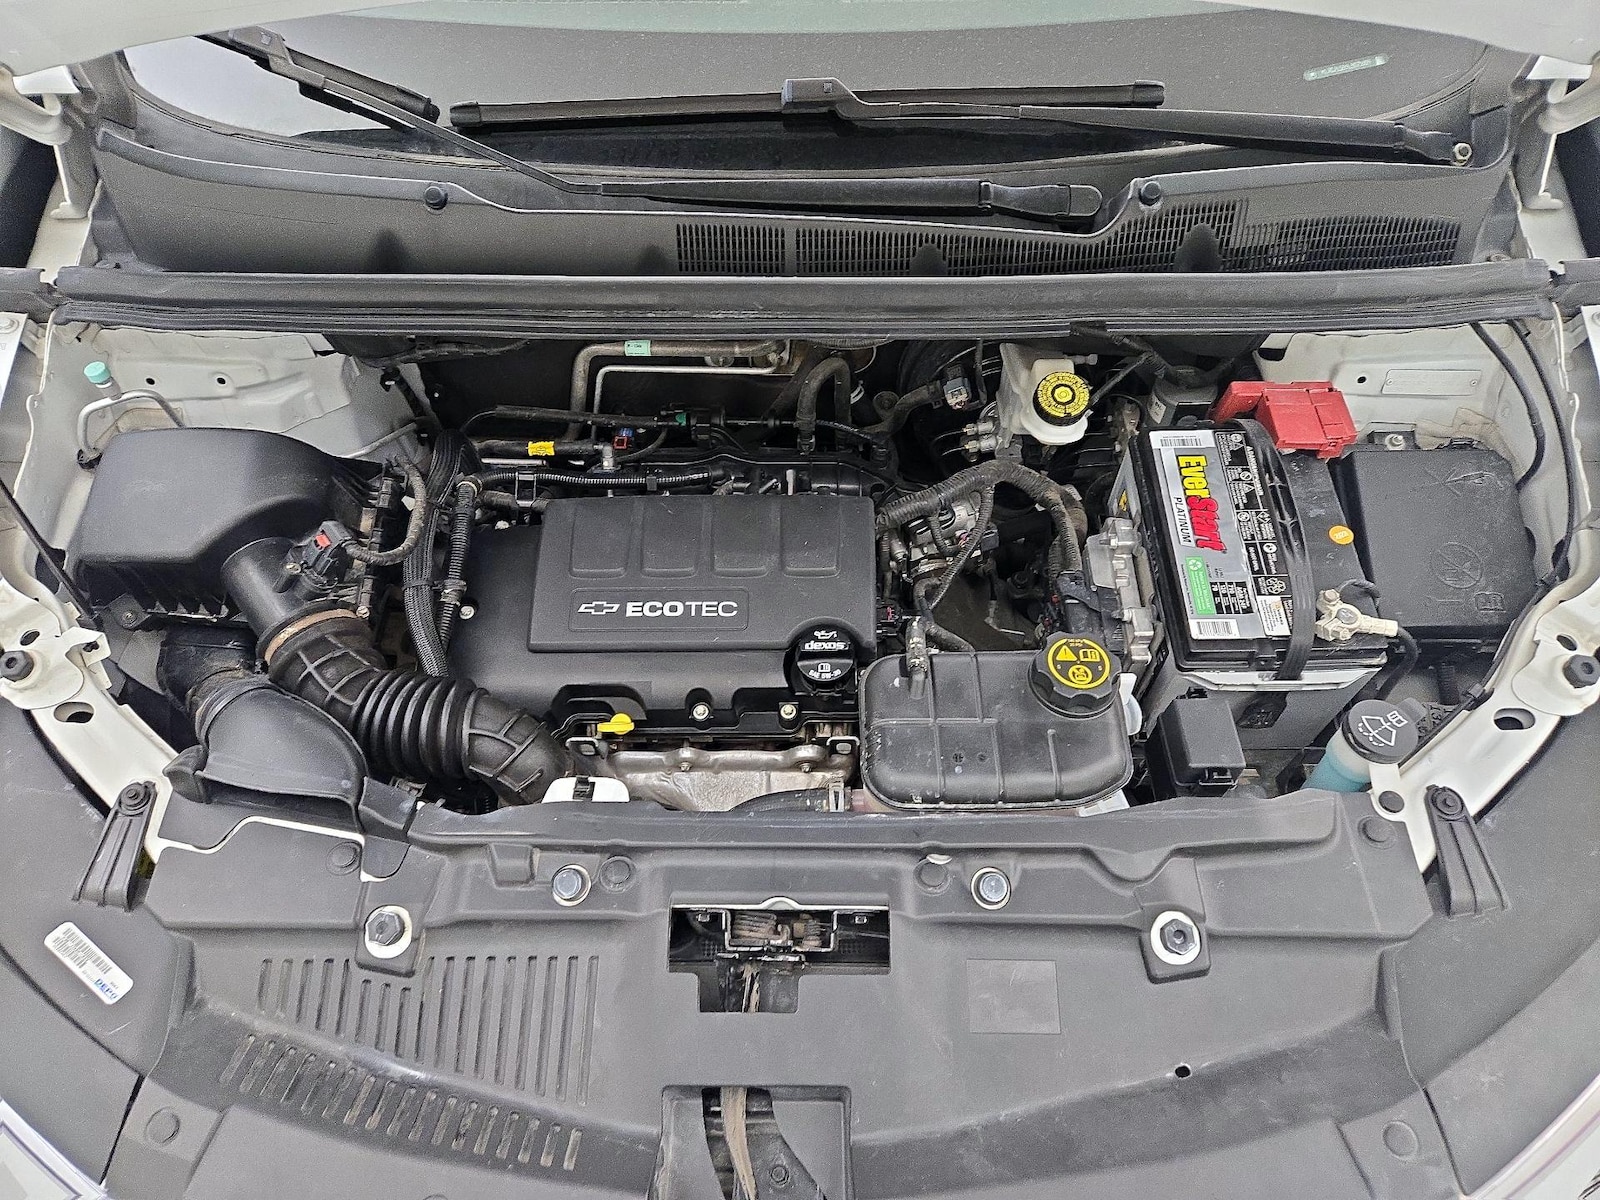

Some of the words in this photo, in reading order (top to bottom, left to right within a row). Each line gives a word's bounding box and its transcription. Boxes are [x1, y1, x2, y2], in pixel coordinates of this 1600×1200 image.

[1173, 497, 1193, 547] PLATINUM
[1176, 455, 1227, 554] EverStart
[626, 601, 738, 617] ECOTEC
